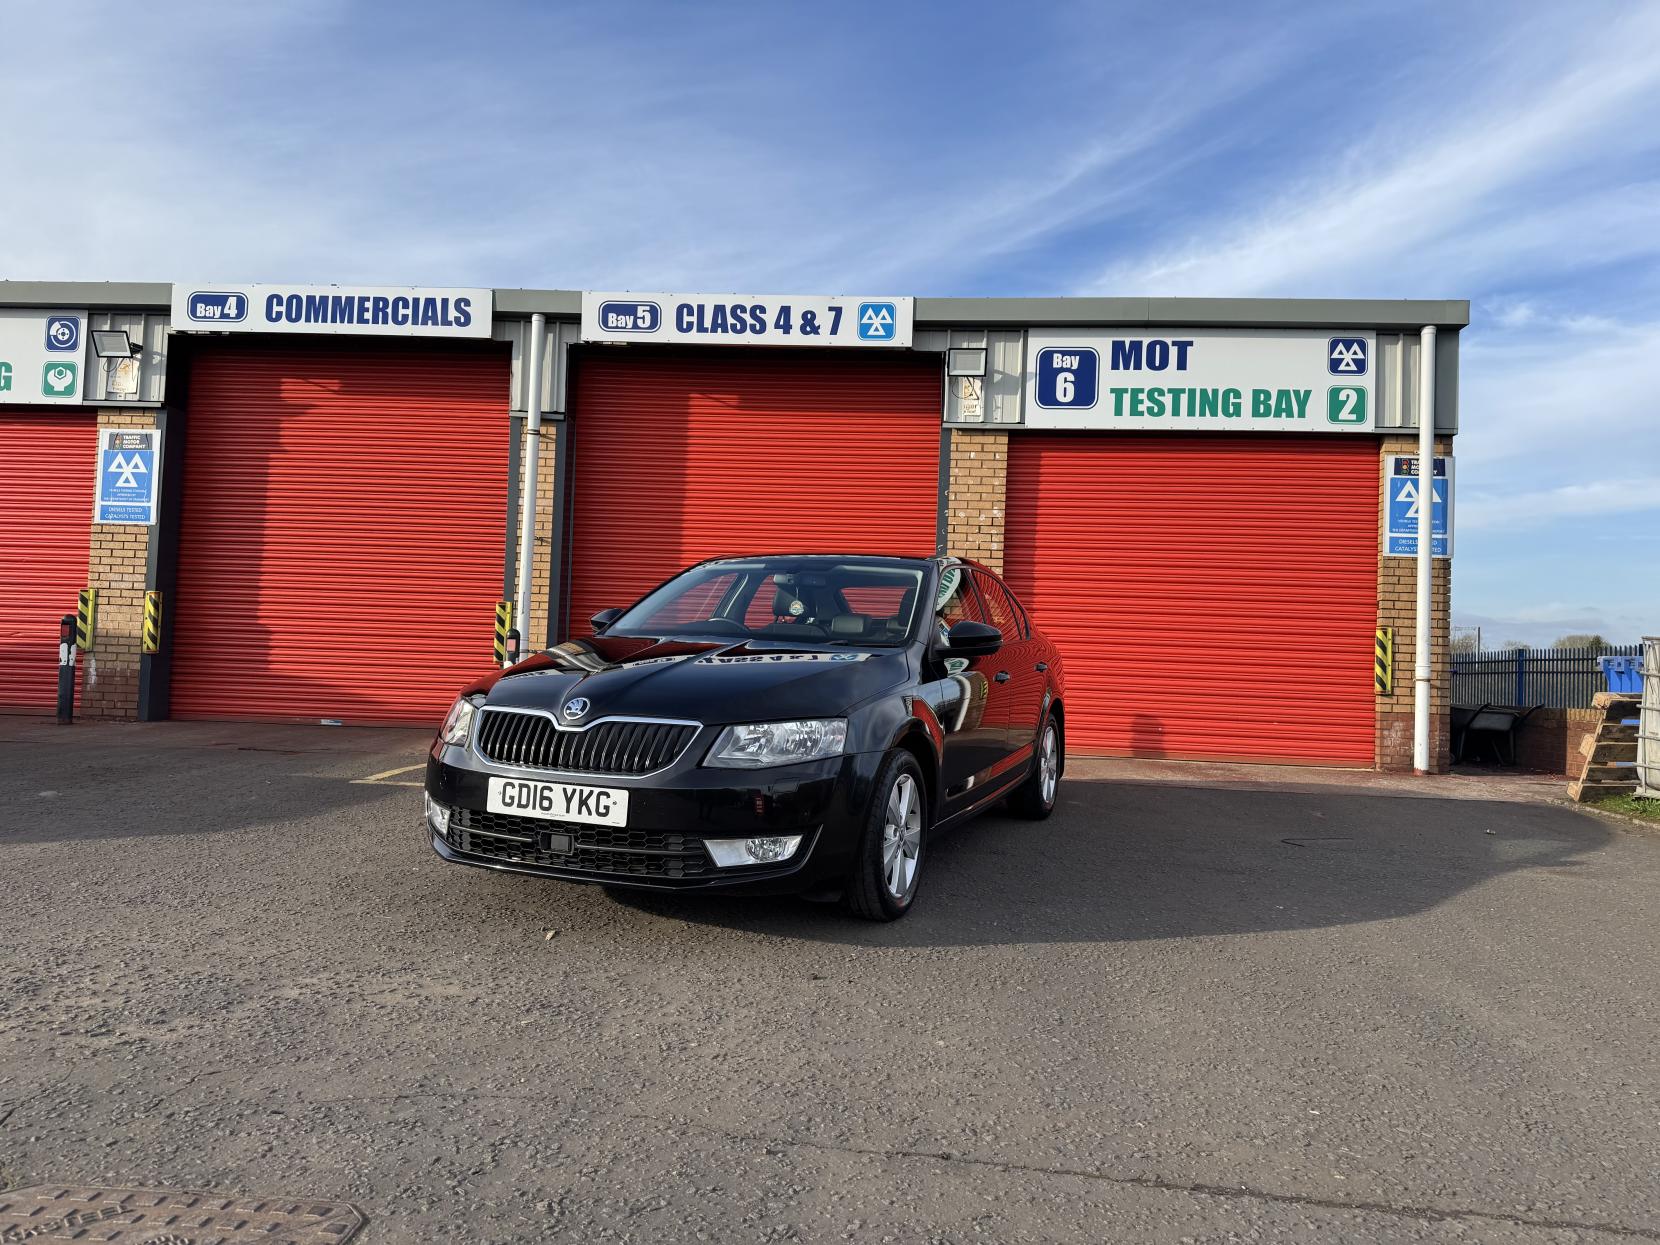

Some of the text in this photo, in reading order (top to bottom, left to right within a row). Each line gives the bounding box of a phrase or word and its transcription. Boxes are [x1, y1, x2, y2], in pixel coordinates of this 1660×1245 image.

[196, 296, 238, 320] Bay 4
[264, 293, 472, 328] COMMERCIALS
[607, 306, 651, 329] Bay 5
[675, 303, 843, 336] CLASS 4 & 7
[1052, 353, 1080, 370] Bay
[1110, 339, 1194, 371] MOT
[1055, 371, 1075, 403] 6
[1109, 386, 1313, 419] TESTING BAY
[1337, 388, 1358, 420] 2
[501, 781, 611, 818] GD16 YKG
